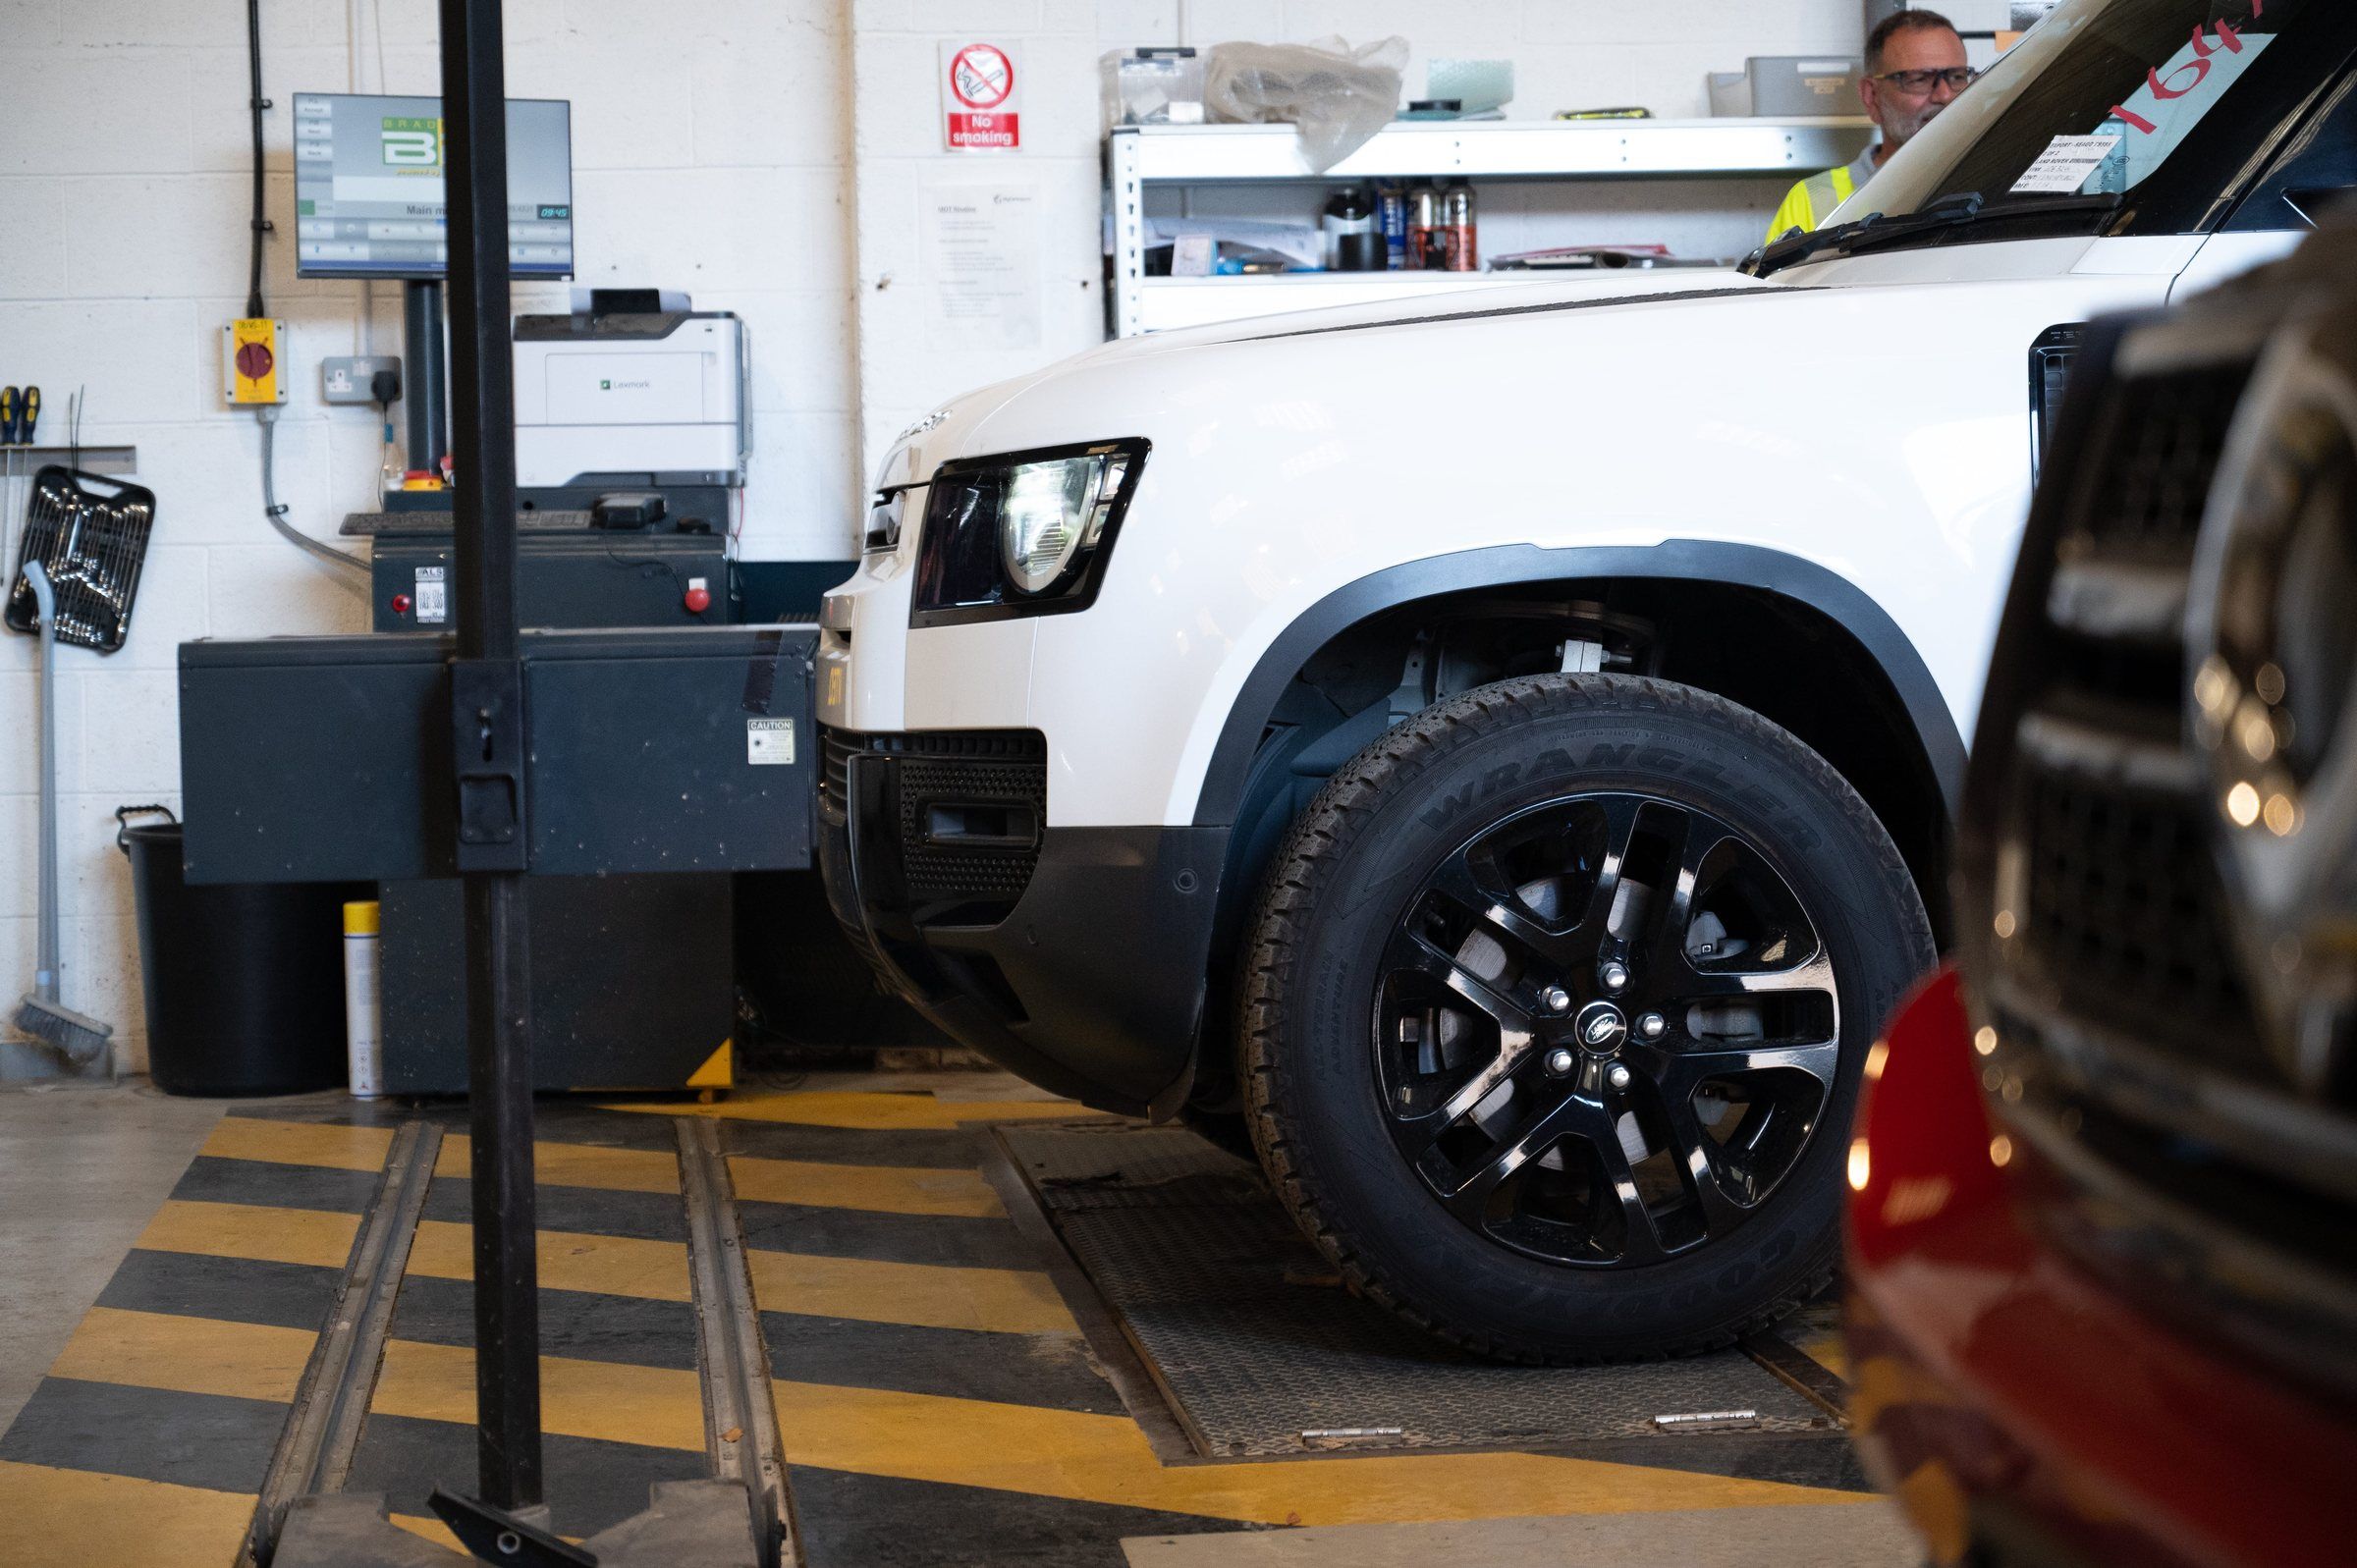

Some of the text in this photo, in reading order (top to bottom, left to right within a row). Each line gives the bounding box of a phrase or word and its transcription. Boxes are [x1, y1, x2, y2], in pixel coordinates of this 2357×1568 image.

[971, 115, 991, 128] No
[953, 132, 1013, 146] smoking
[407, 204, 433, 216] Main
[540, 207, 568, 219] 09:45
[614, 380, 650, 389] Lexmark
[750, 721, 791, 730] CAUTION
[1419, 742, 1824, 856] WRANGLER
